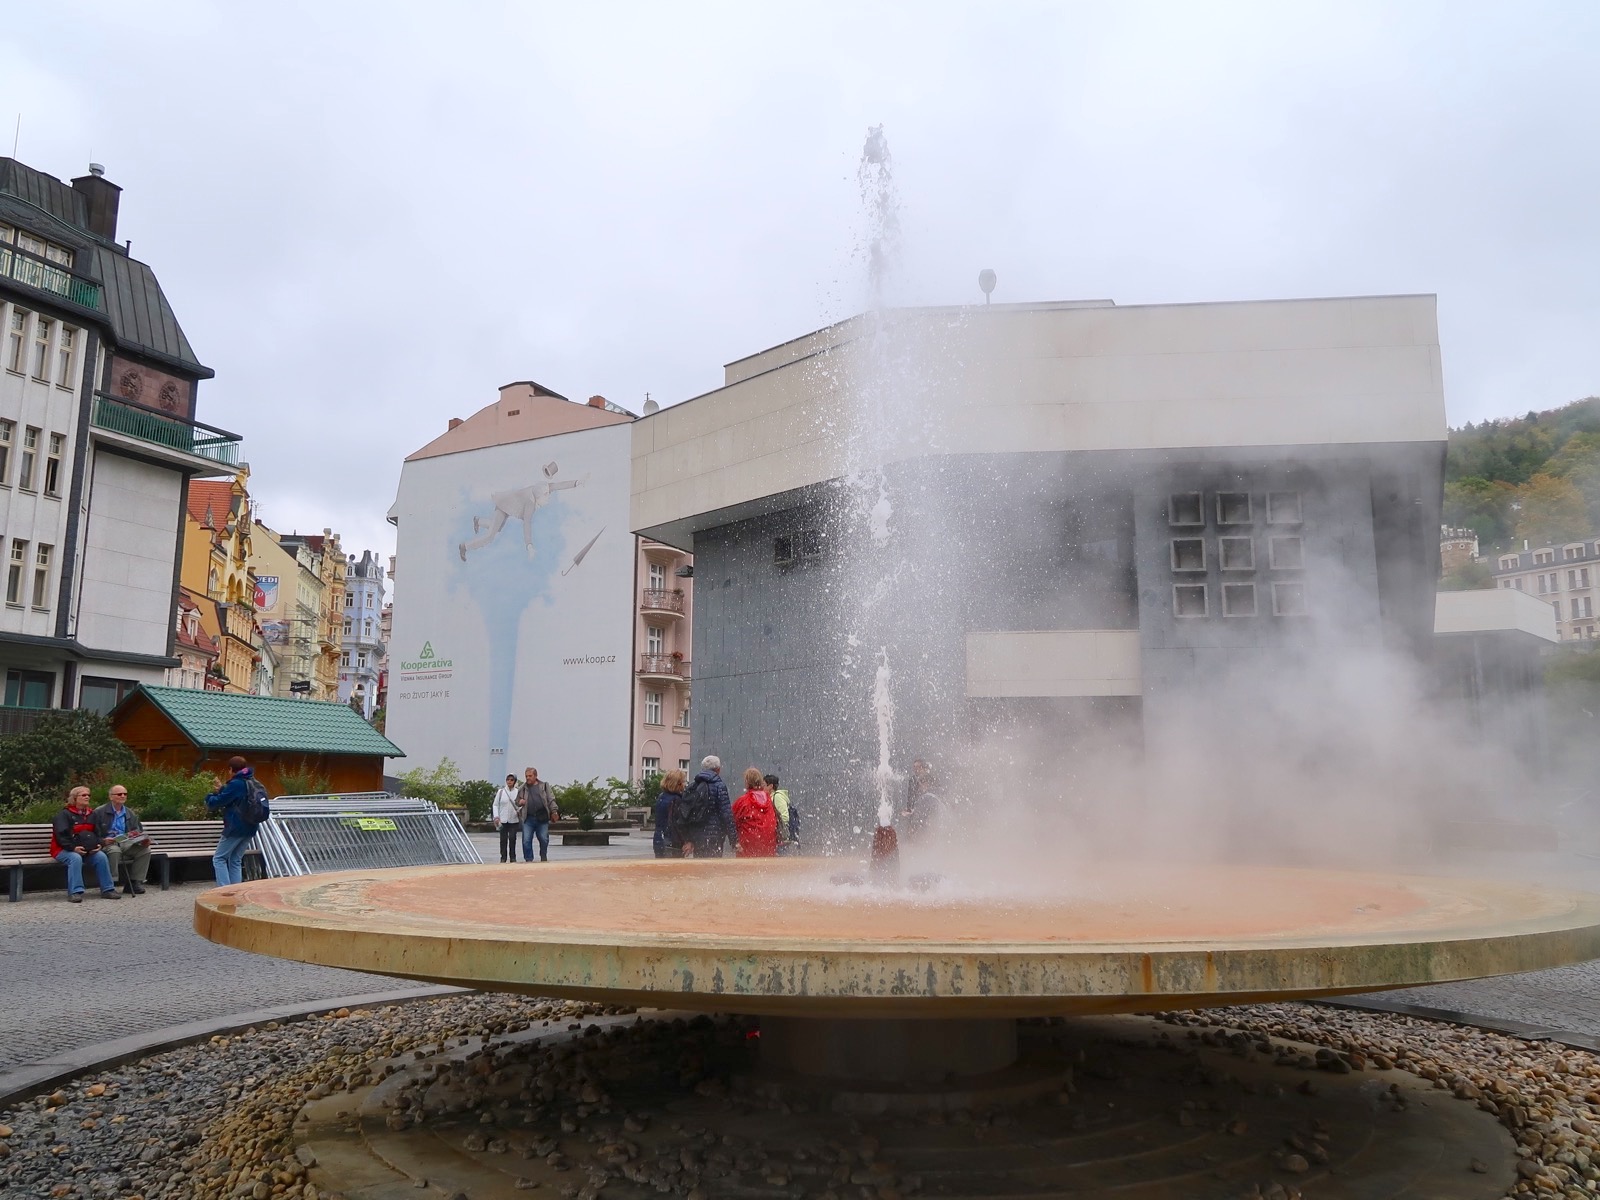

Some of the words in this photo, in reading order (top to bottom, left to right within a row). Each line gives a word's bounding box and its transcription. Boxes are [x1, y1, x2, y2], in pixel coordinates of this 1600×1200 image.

[401, 658, 452, 671] Kooperativa
[563, 654, 616, 665] www.koop.cz
[400, 692, 411, 700] PRO
[412, 691, 430, 699] ŽIVOT
[430, 690, 443, 698] JAKÝ
[444, 690, 450, 698] JE
